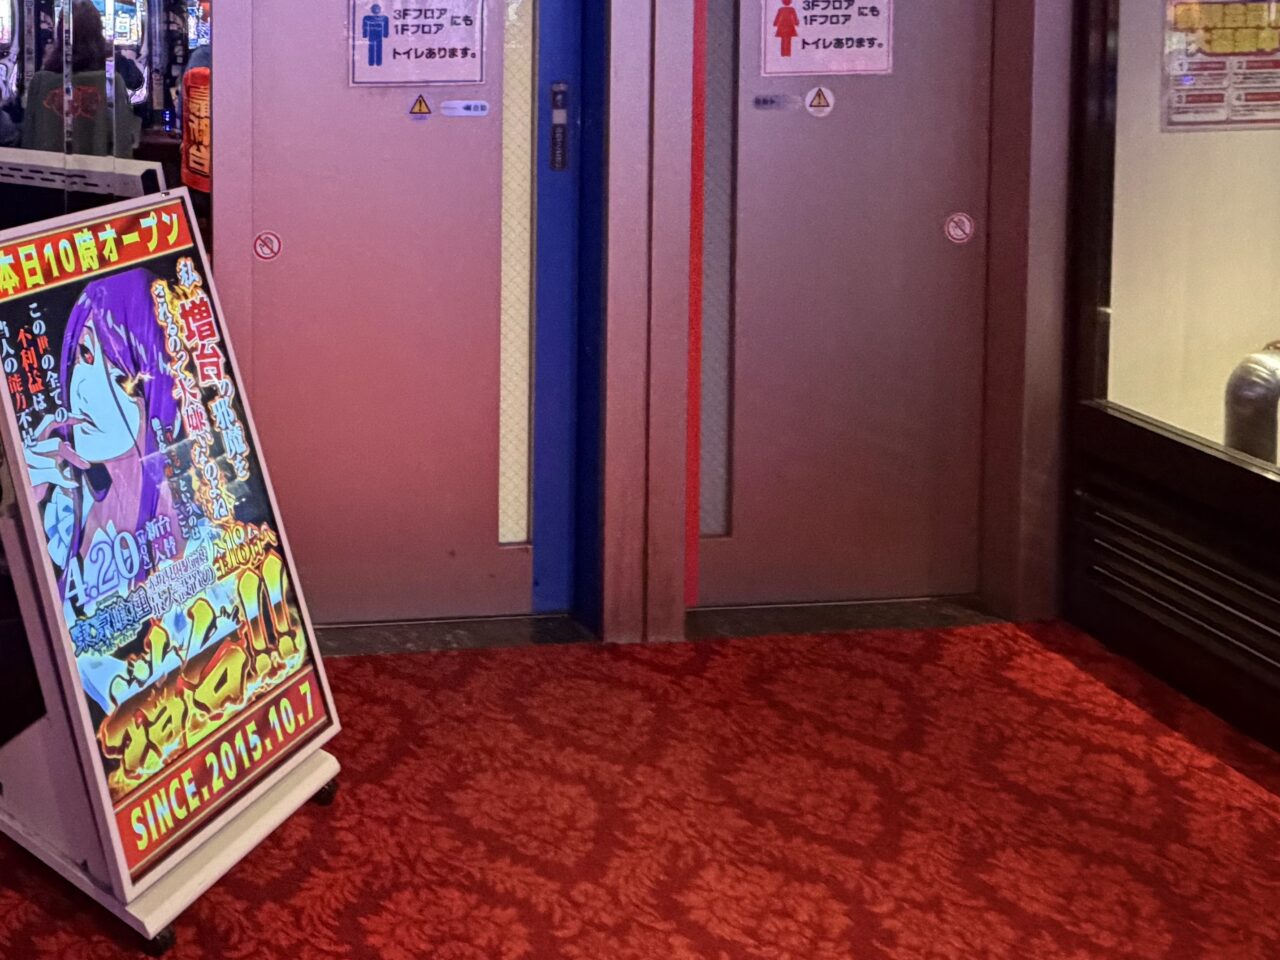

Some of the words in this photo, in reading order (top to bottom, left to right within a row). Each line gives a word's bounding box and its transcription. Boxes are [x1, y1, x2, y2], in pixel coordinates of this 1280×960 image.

[802, 0, 855, 11] 3Fフロア
[857, 6, 880, 17] にも
[393, 8, 447, 20] 3Fフロア
[803, 14, 852, 26] 1Fフロア
[451, 15, 473, 27] にも
[393, 23, 444, 35] 1Fフロア
[800, 37, 883, 50] トイレあります。
[392, 47, 477, 60] トイレあります。
[145, 514, 171, 542] 新台
[64, 530, 140, 607] 4.20
[131, 680, 315, 851] SINCE.2015.10.7
